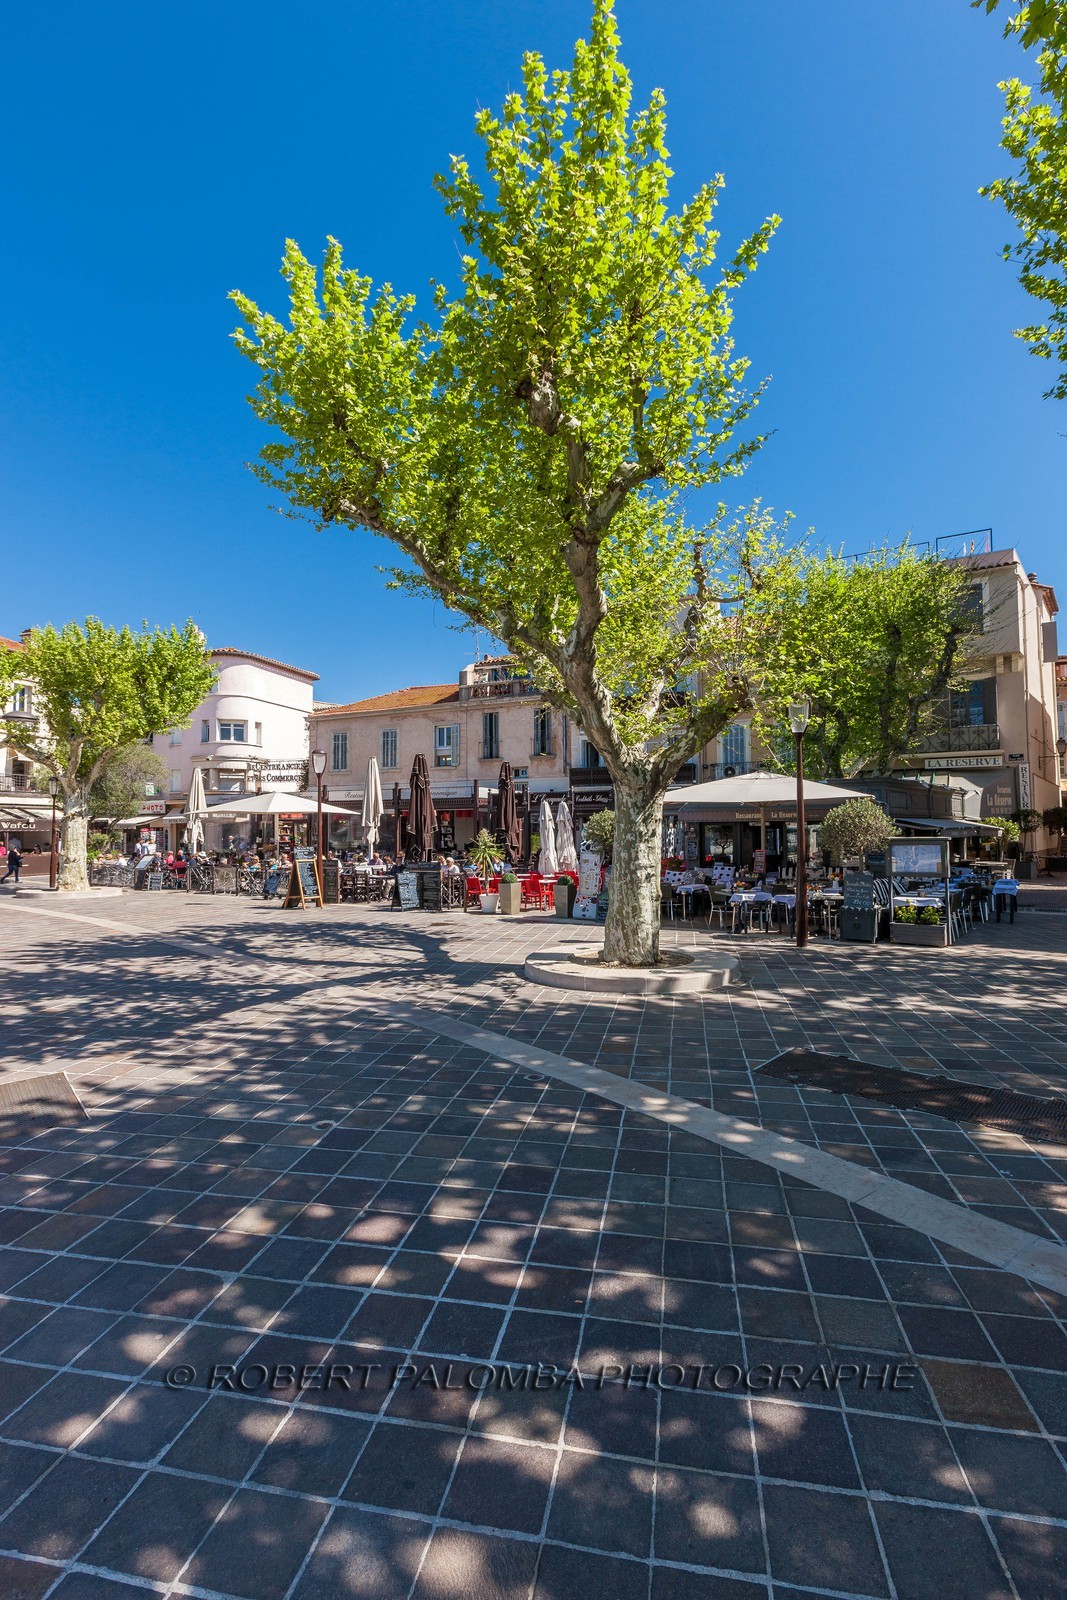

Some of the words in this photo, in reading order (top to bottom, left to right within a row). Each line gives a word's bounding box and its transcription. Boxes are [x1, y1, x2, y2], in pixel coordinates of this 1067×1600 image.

[927, 760, 941, 768] LA
[946, 757, 1000, 767] RESERVE
[266, 773, 303, 782] COMMERCE
[1020, 766, 1029, 809] RESTAUR
[779, 811, 797, 819] Réserv
